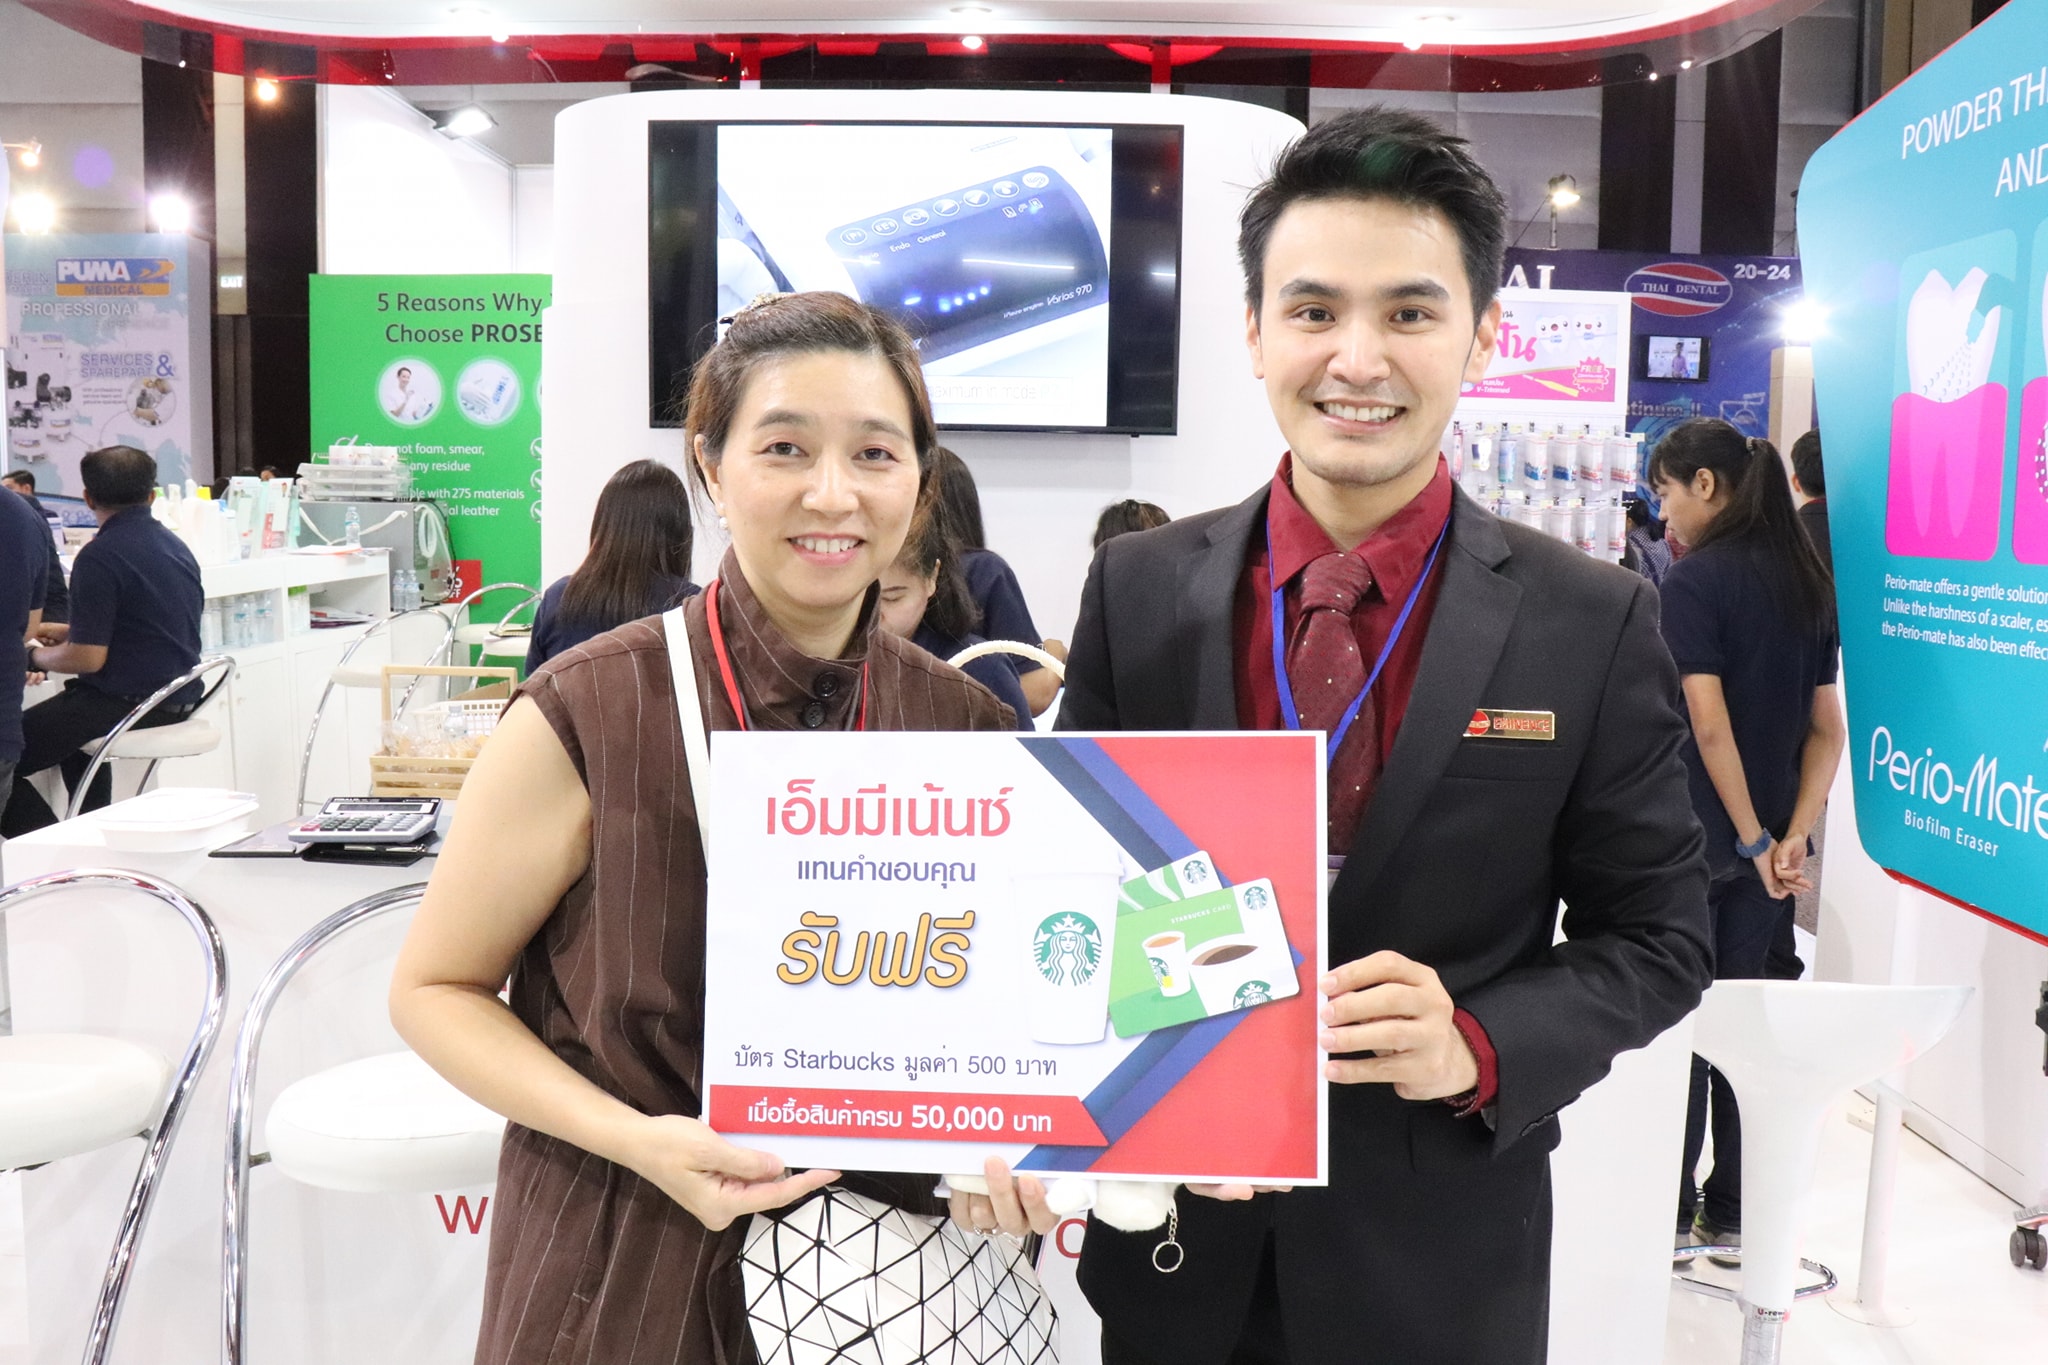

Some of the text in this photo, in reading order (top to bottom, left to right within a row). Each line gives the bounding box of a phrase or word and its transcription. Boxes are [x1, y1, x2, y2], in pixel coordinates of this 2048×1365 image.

[1902, 66, 2048, 160] POWDER TH
[889, 229, 947, 253] Endo General
[57, 260, 130, 282] PUMA
[1733, 263, 1791, 281] 20-24
[84, 284, 143, 296] MEDICAL
[1046, 290, 1075, 307] Varios
[1075, 283, 1093, 297] 970
[1641, 282, 1720, 296] THAI DENTAL
[22, 302, 139, 317] PROFESSIONAL
[377, 292, 542, 317] 5 Reasons Why
[385, 323, 464, 343] Choose
[80, 353, 175, 377] SERVICES &
[415, 443, 447, 456] foam,
[448, 445, 485, 457] smear,
[410, 461, 471, 473] any residue
[427, 488, 450, 499] with
[452, 488, 471, 499] 275
[473, 488, 525, 500] materials
[461, 505, 500, 517] leather
[1885, 573, 1933, 593] Perio-mate
[1934, 578, 1961, 596] offers
[1962, 585, 1970, 597] a
[1971, 582, 2006, 602] gentle
[1883, 597, 1911, 615] Unlike
[1911, 602, 1927, 617] the
[1928, 603, 1976, 624] harshness
[1978, 609, 1990, 625] of
[1990, 613, 1998, 626] a
[2000, 612, 2034, 633] scaler,
[1882, 621, 1896, 636] the
[1897, 623, 1947, 645] Perio-mate
[1948, 629, 1966, 648] has
[1967, 633, 1988, 651] also
[1990, 636, 2018, 656] been
[1493, 716, 1551, 732] EMINENCE
[766, 778, 1015, 838] เอ็มมีเน้นซ์
[1904, 809, 1999, 857] Biofilm Eraser
[797, 854, 977, 890] แทนคำขอบคุณ
[776, 910, 977, 990] รับฟรี
[734, 1045, 1058, 1082] บัตร Starbucks มูลค่า 500 บาท
[747, 1097, 1053, 1133] เมื่อซื้อสินค้าครบ 50,000 บาท
